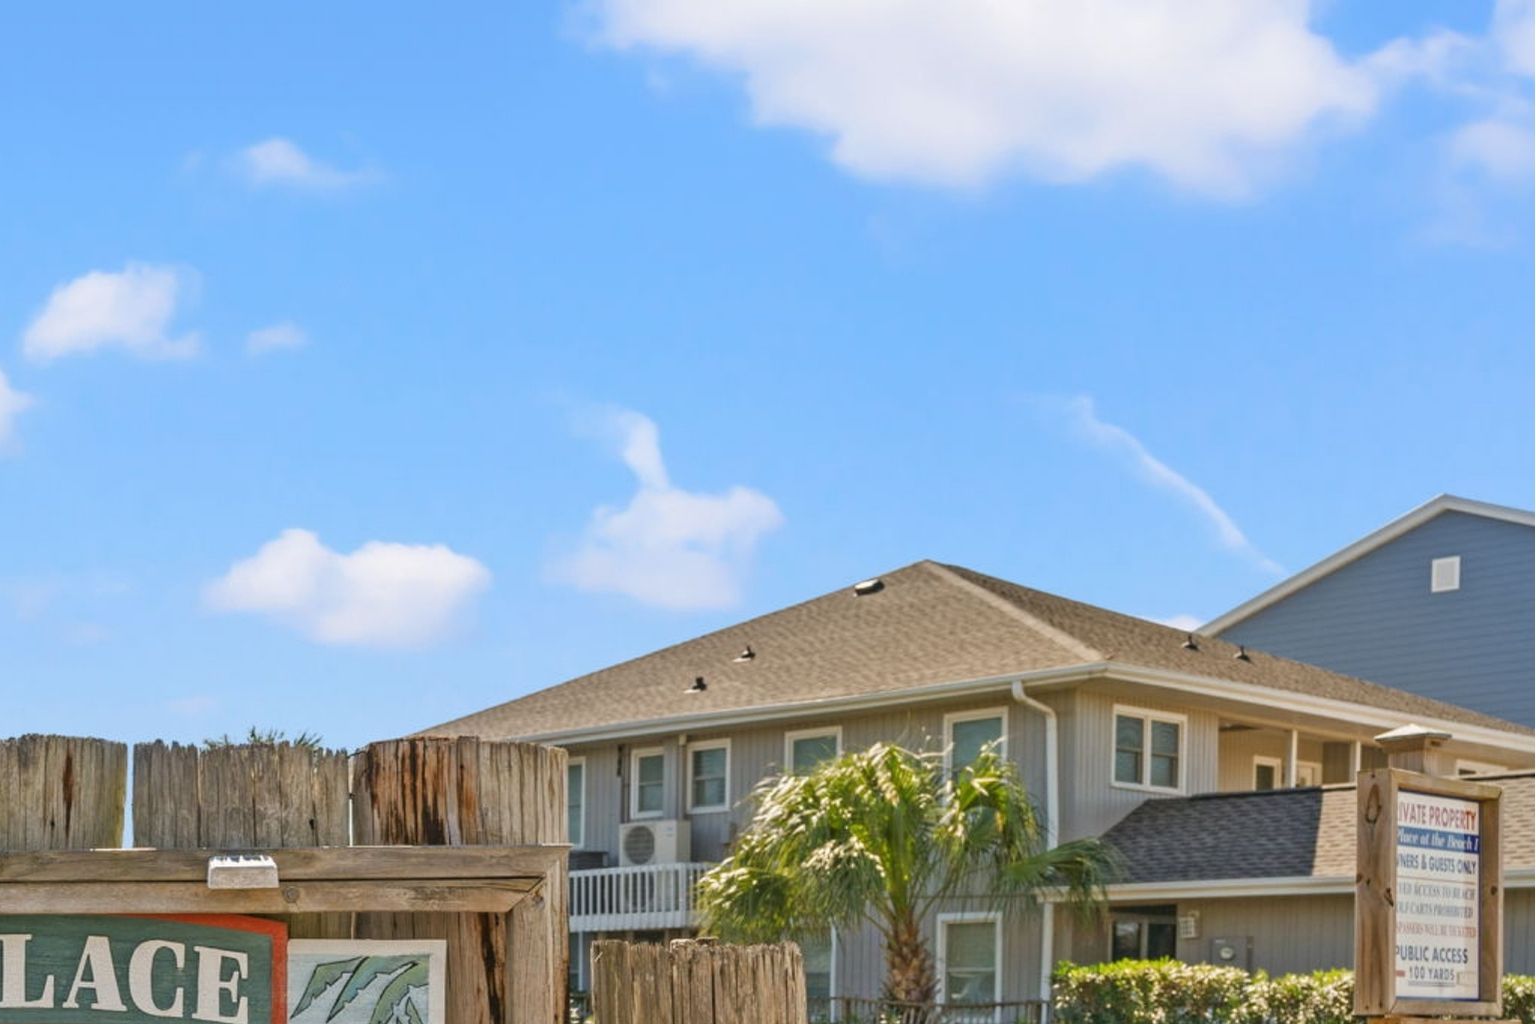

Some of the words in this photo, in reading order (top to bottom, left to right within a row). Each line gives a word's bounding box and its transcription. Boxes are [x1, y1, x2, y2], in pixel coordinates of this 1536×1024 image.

[1398, 802, 1428, 827] IVATE
[1429, 806, 1477, 831] PROPERTY
[1429, 856, 1455, 874] GUESTS
[1457, 858, 1477, 875] ONLY
[1395, 945, 1429, 962] PUBLIC
[1431, 947, 1468, 965] ACCESS
[1408, 965, 1425, 980] 100
[1427, 967, 1455, 982] YARDS
